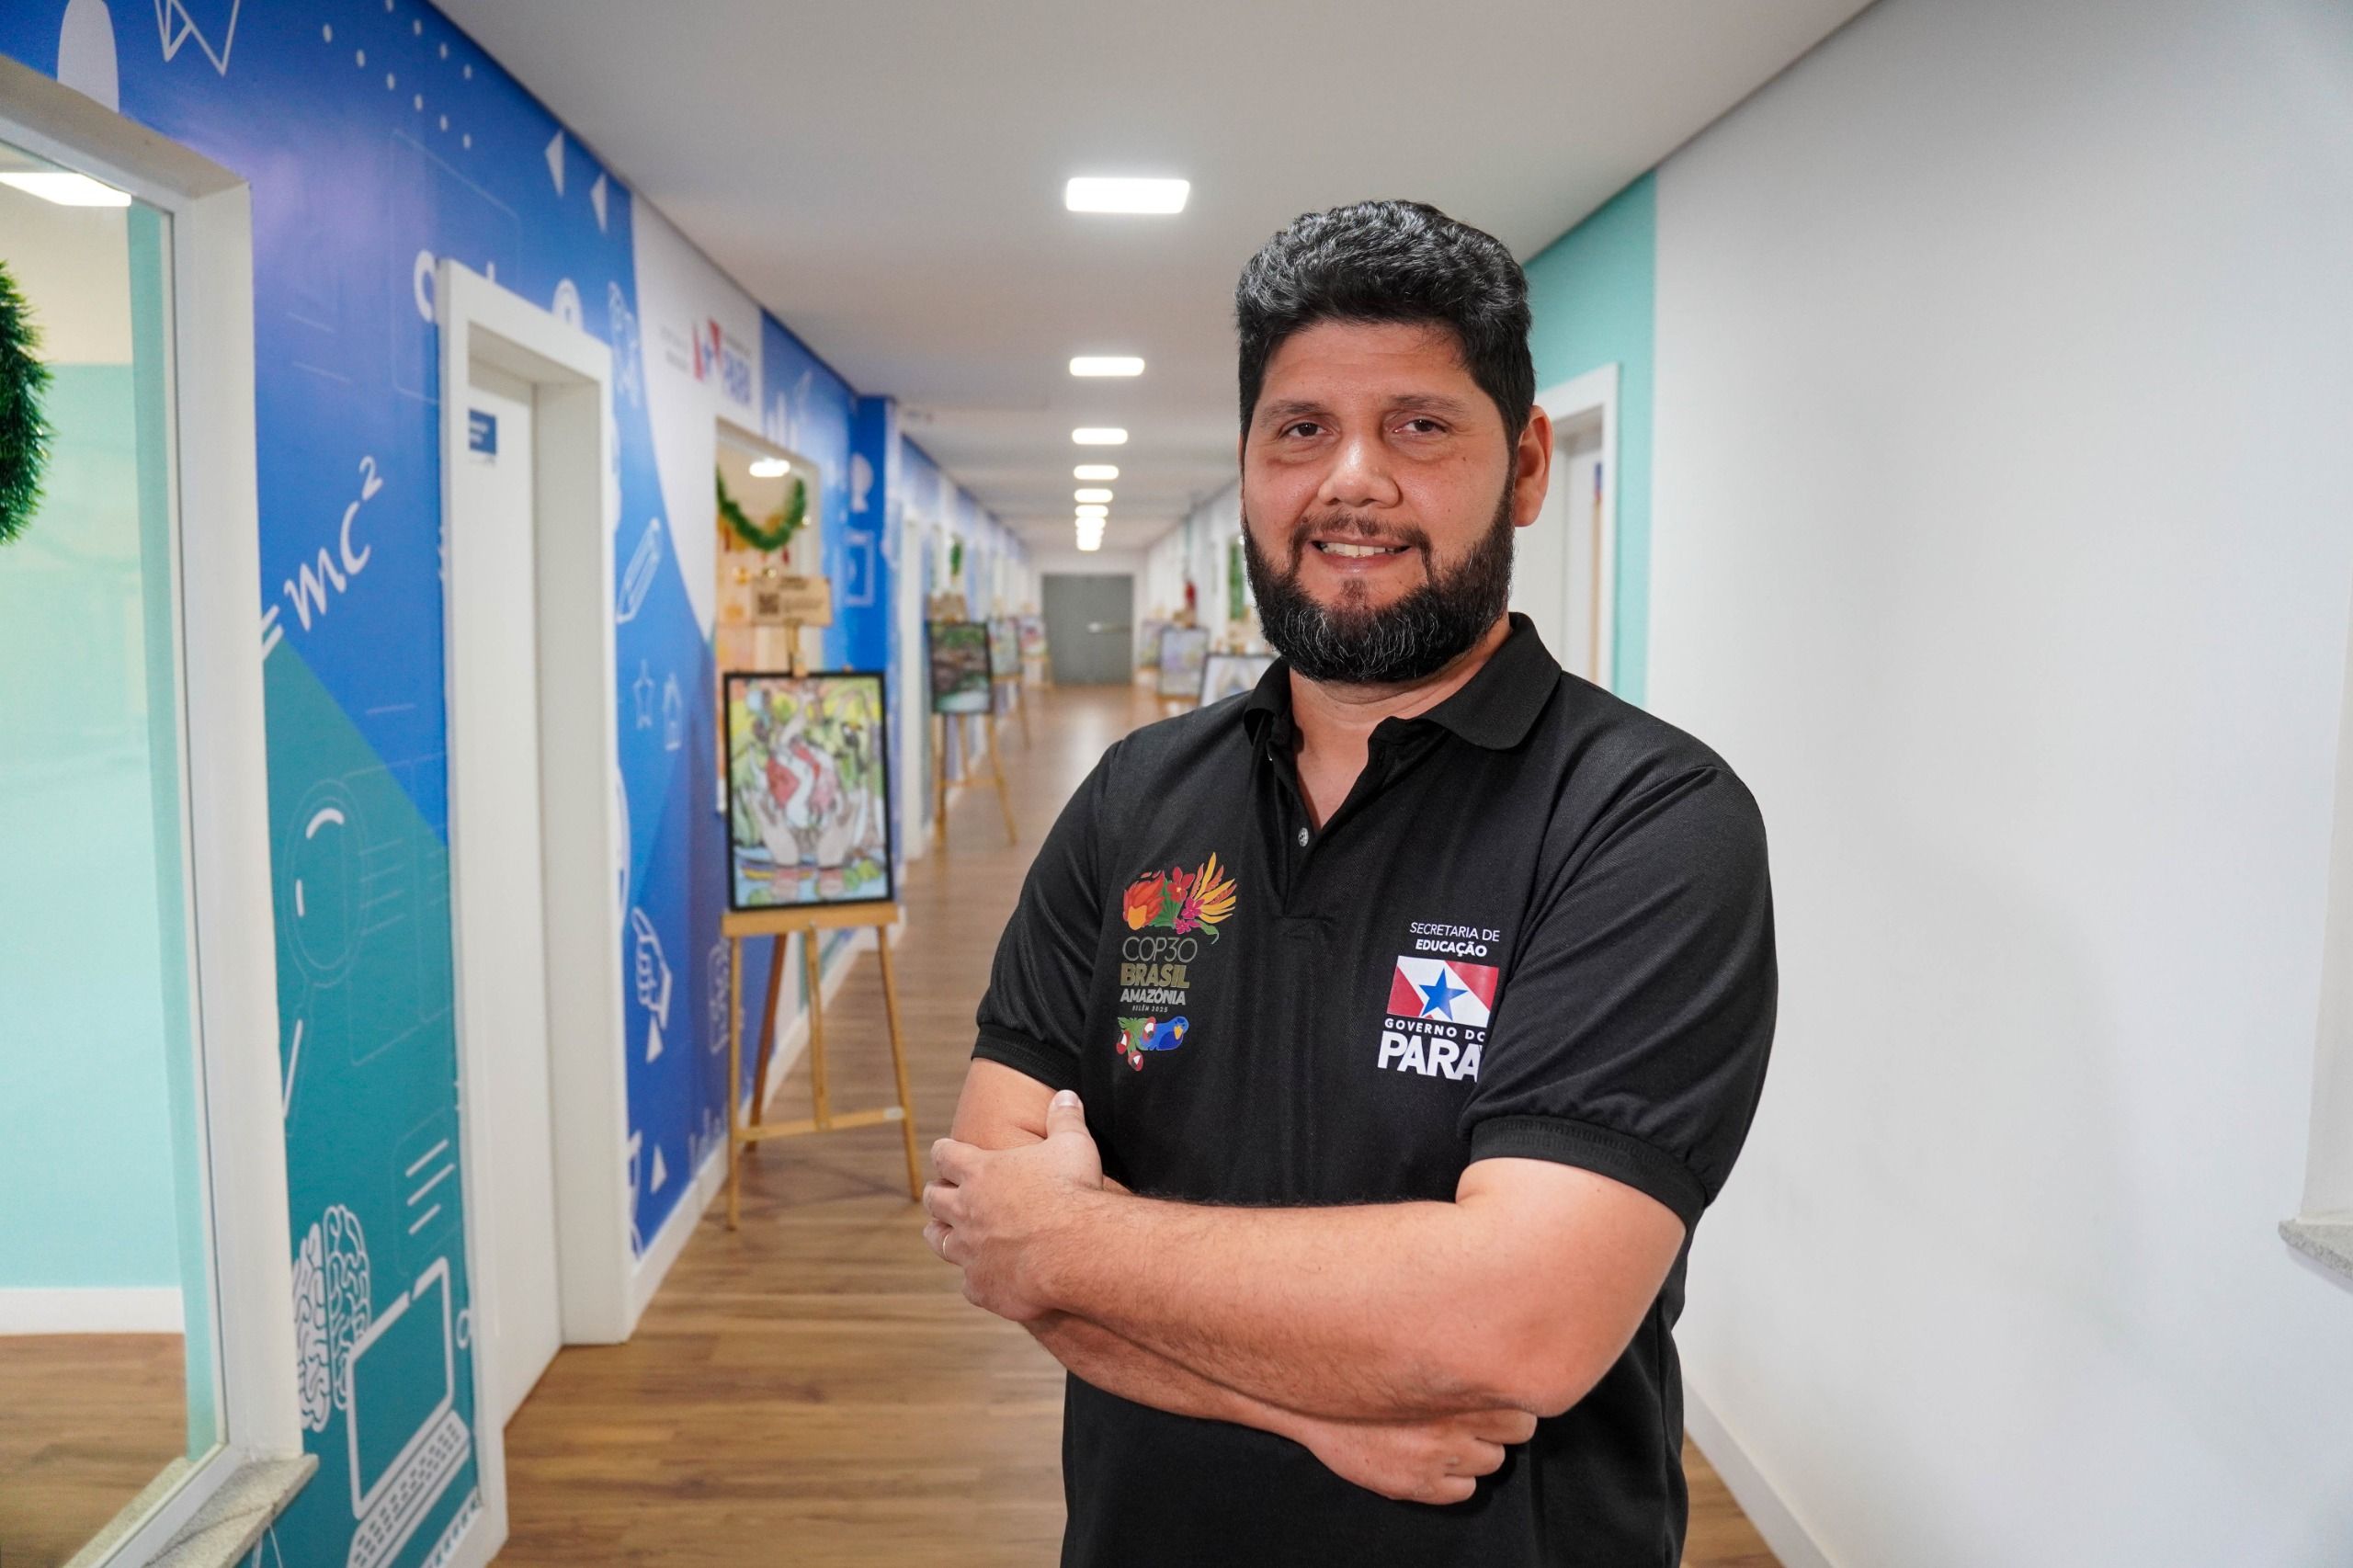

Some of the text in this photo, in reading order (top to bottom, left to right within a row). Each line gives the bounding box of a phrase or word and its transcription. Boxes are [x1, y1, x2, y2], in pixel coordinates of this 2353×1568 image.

[1409, 922, 1500, 942] SECRETARIA DE
[1122, 937, 1198, 962] COP30
[1415, 938, 1487, 957] EDUCAÇÃO
[1120, 962, 1189, 988] BRASIL
[1120, 987, 1187, 1006] AMAZÔNIA
[1384, 1018, 1457, 1038] GOVERNO
